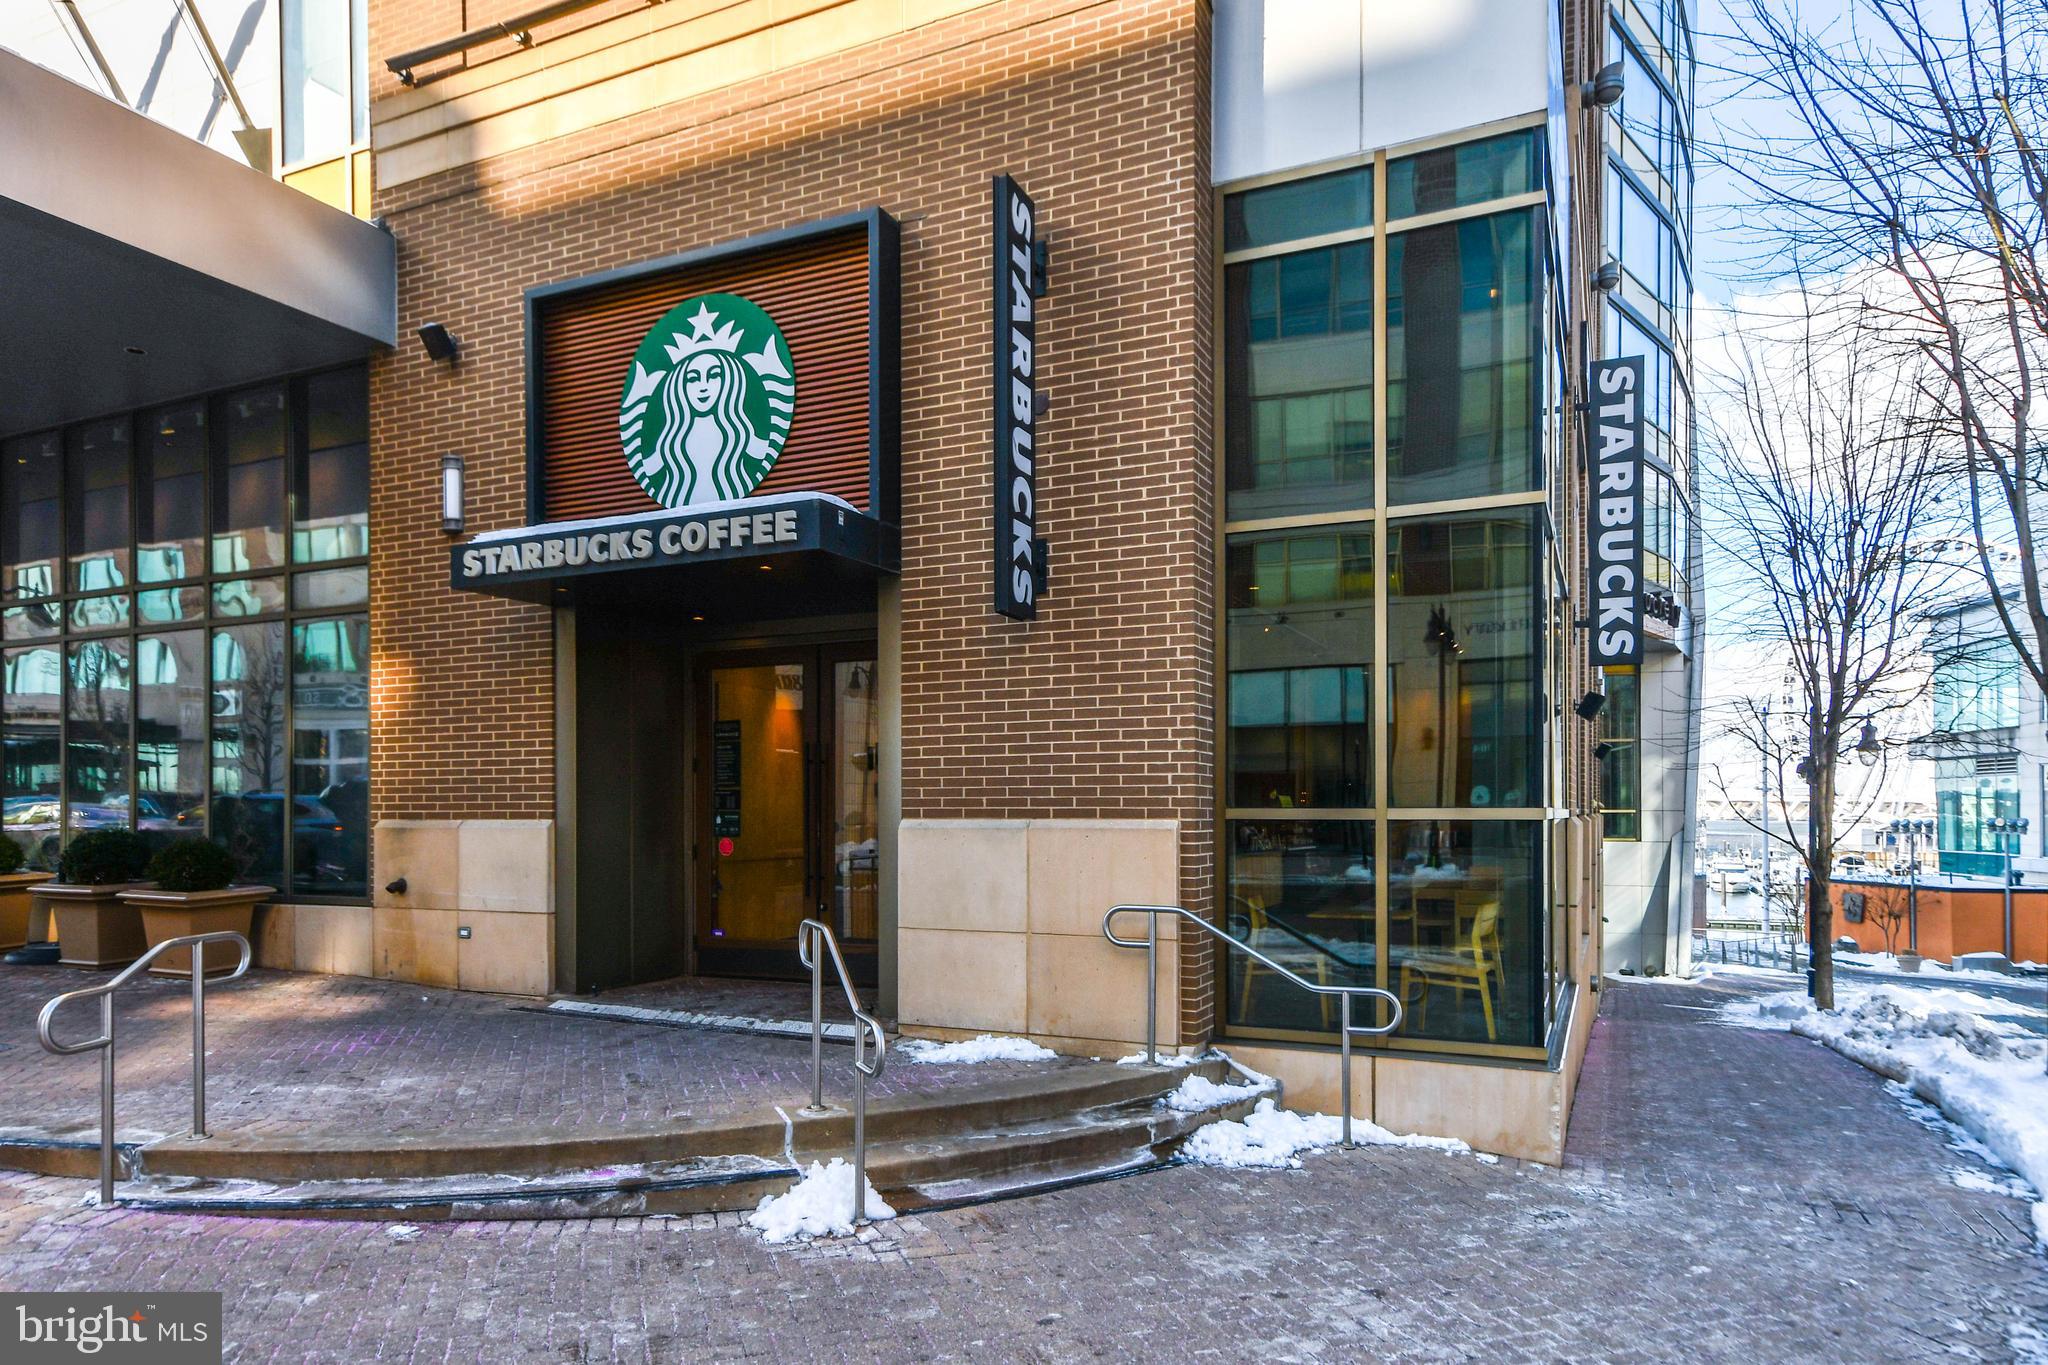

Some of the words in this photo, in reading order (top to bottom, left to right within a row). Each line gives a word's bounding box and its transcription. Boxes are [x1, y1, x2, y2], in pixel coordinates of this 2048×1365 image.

[463, 528, 654, 578] STARBUCKS
[659, 509, 798, 555] COFFEE
[1011, 192, 1032, 606] STARBUCKS
[1598, 364, 1635, 657] STARBUCKS
